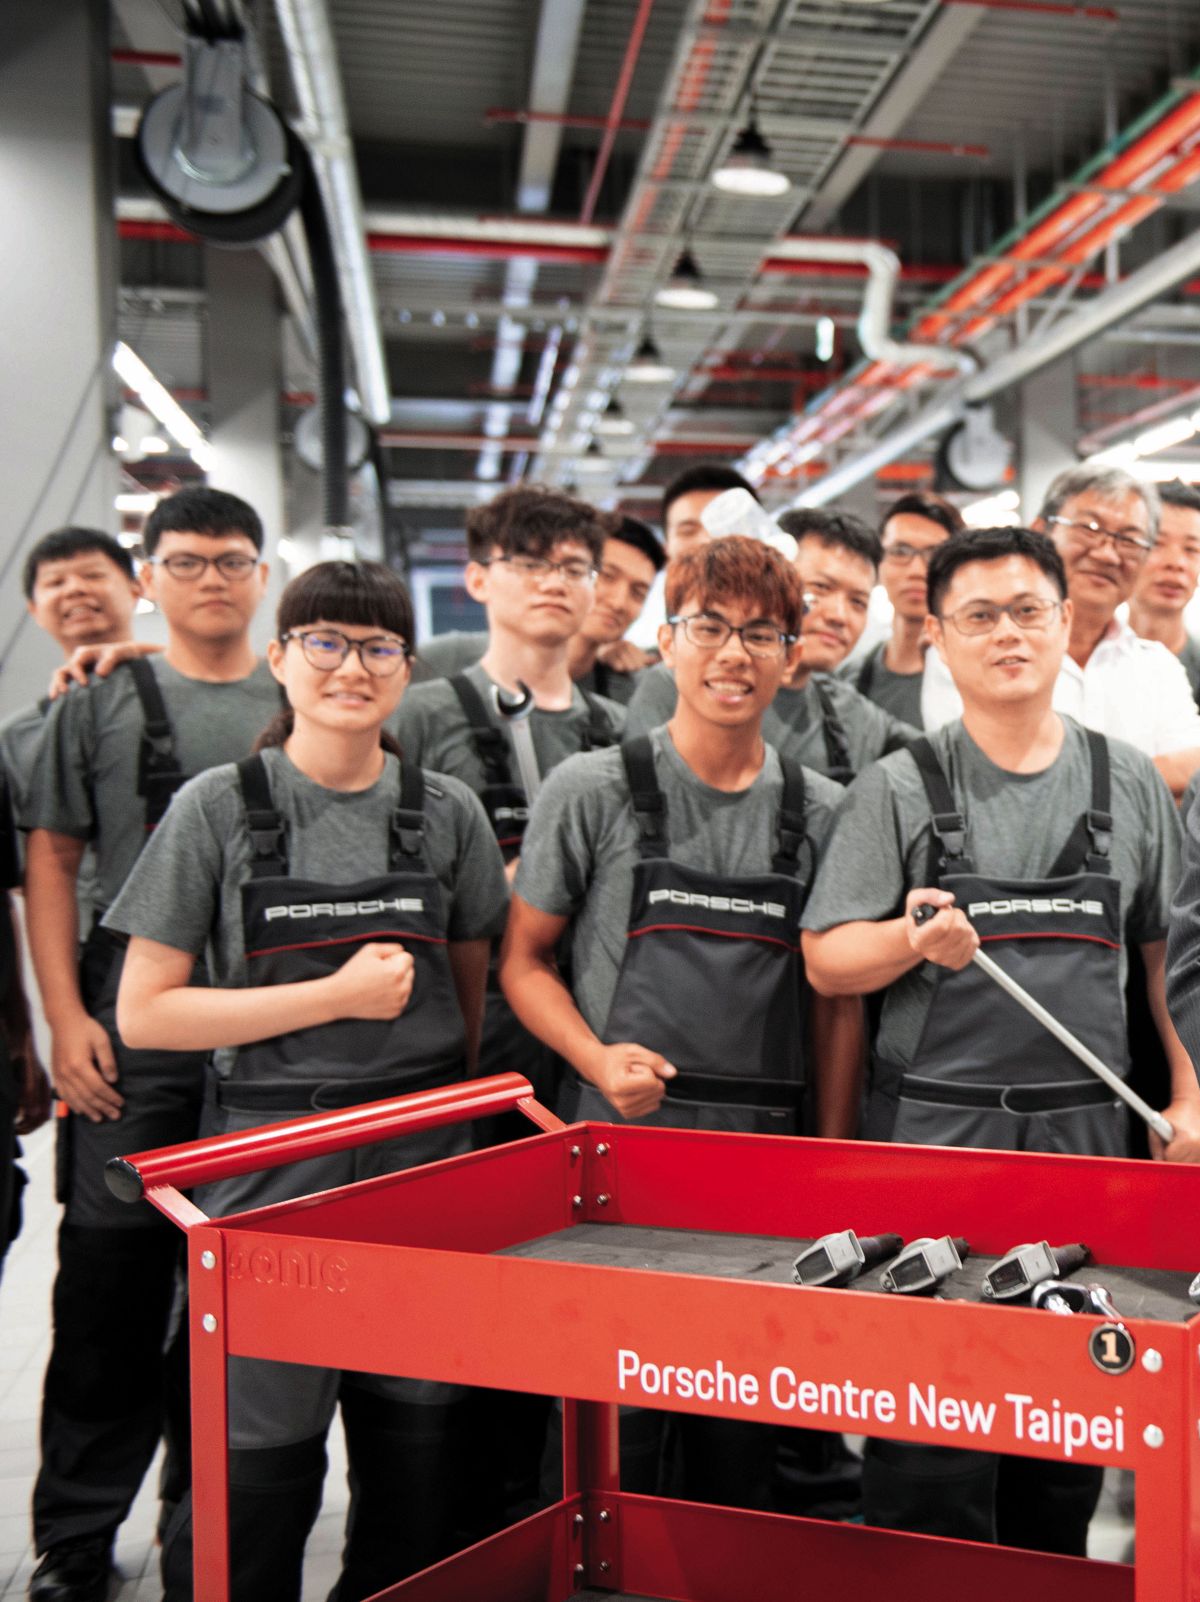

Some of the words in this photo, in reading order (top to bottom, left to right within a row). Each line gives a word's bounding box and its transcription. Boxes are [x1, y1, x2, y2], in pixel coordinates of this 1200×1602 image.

[264, 898, 424, 921] PORSCHE
[648, 888, 787, 918] PORSCHE
[968, 899, 1104, 917] PORSCHE
[1100, 1331, 1121, 1363] 1
[617, 1348, 760, 1406] Porsche
[769, 1365, 896, 1424] Centre
[908, 1382, 997, 1435] New
[1004, 1393, 1125, 1457] Taipei
